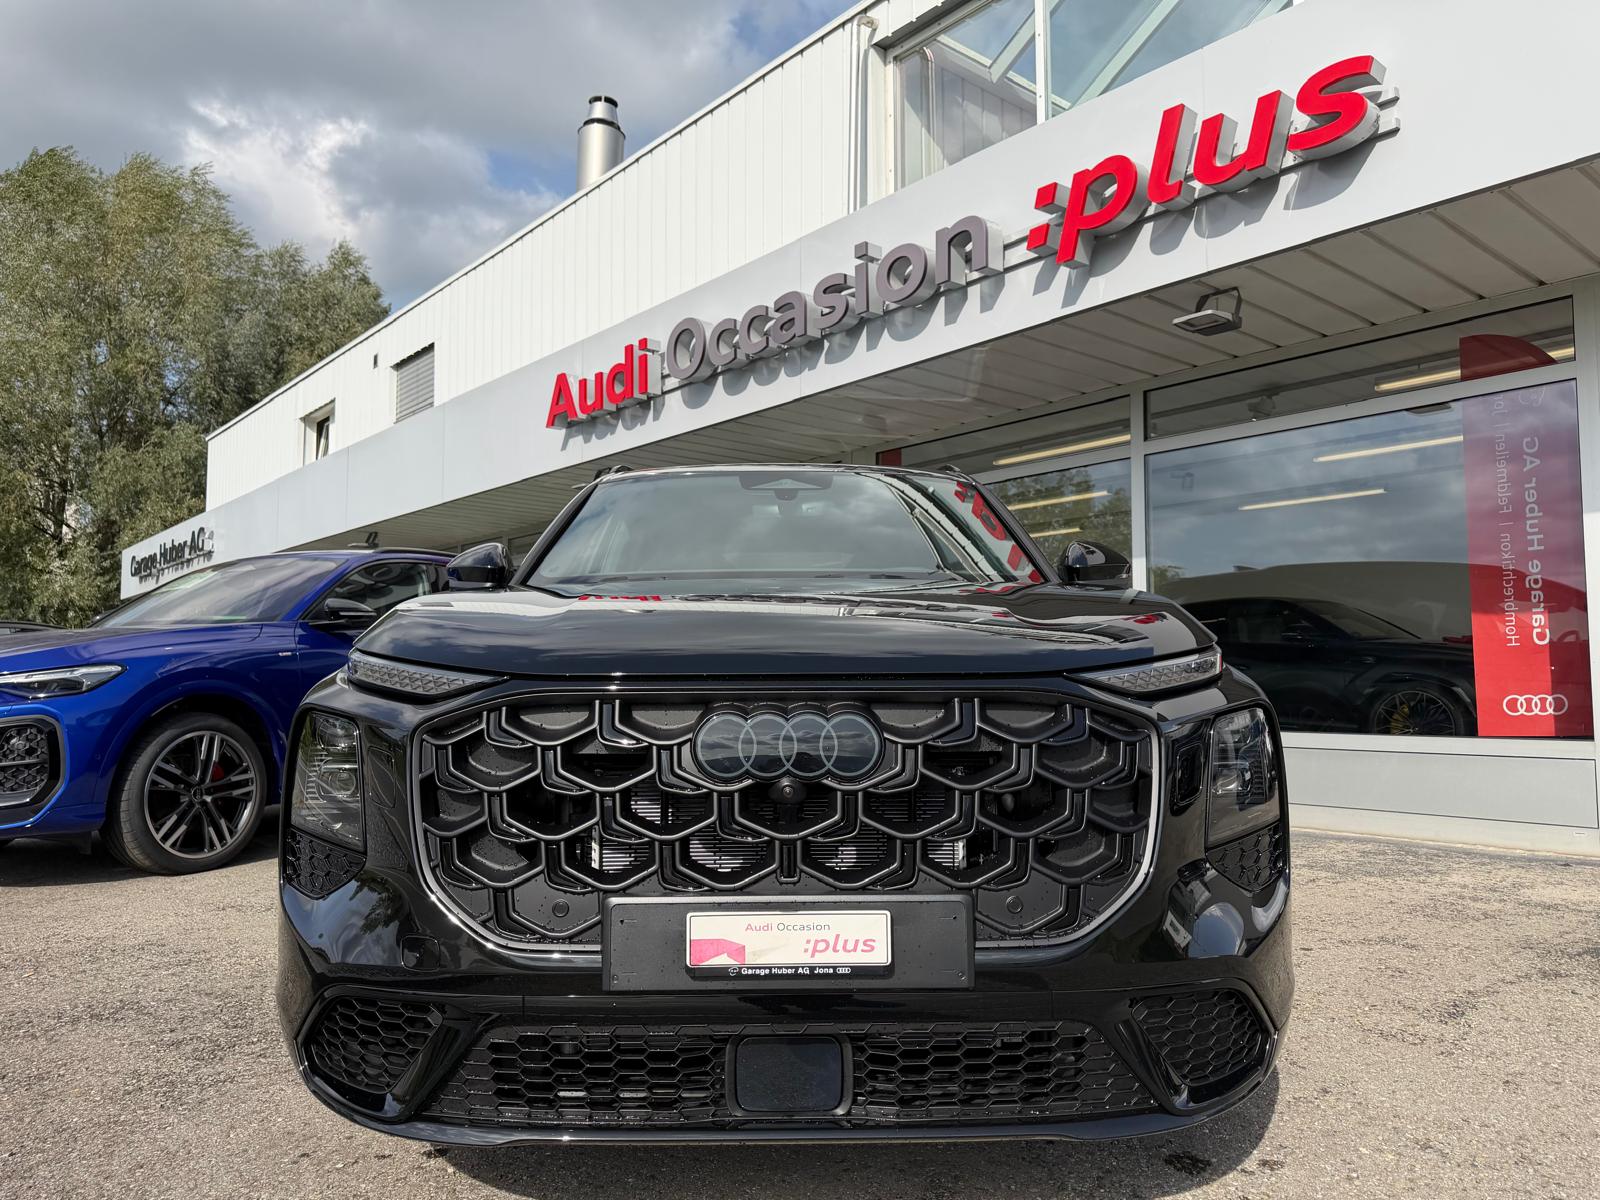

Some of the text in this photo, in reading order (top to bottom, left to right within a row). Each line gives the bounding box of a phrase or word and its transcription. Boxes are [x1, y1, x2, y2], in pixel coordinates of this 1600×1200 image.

[546, 55, 1375, 428] Audi Occasion :plus
[130, 527, 205, 577] Garage Huber AG
[745, 922, 831, 932] Audi Occasion
[803, 933, 877, 958] :plus
[741, 966, 834, 976] Garage Huber AG Jona
